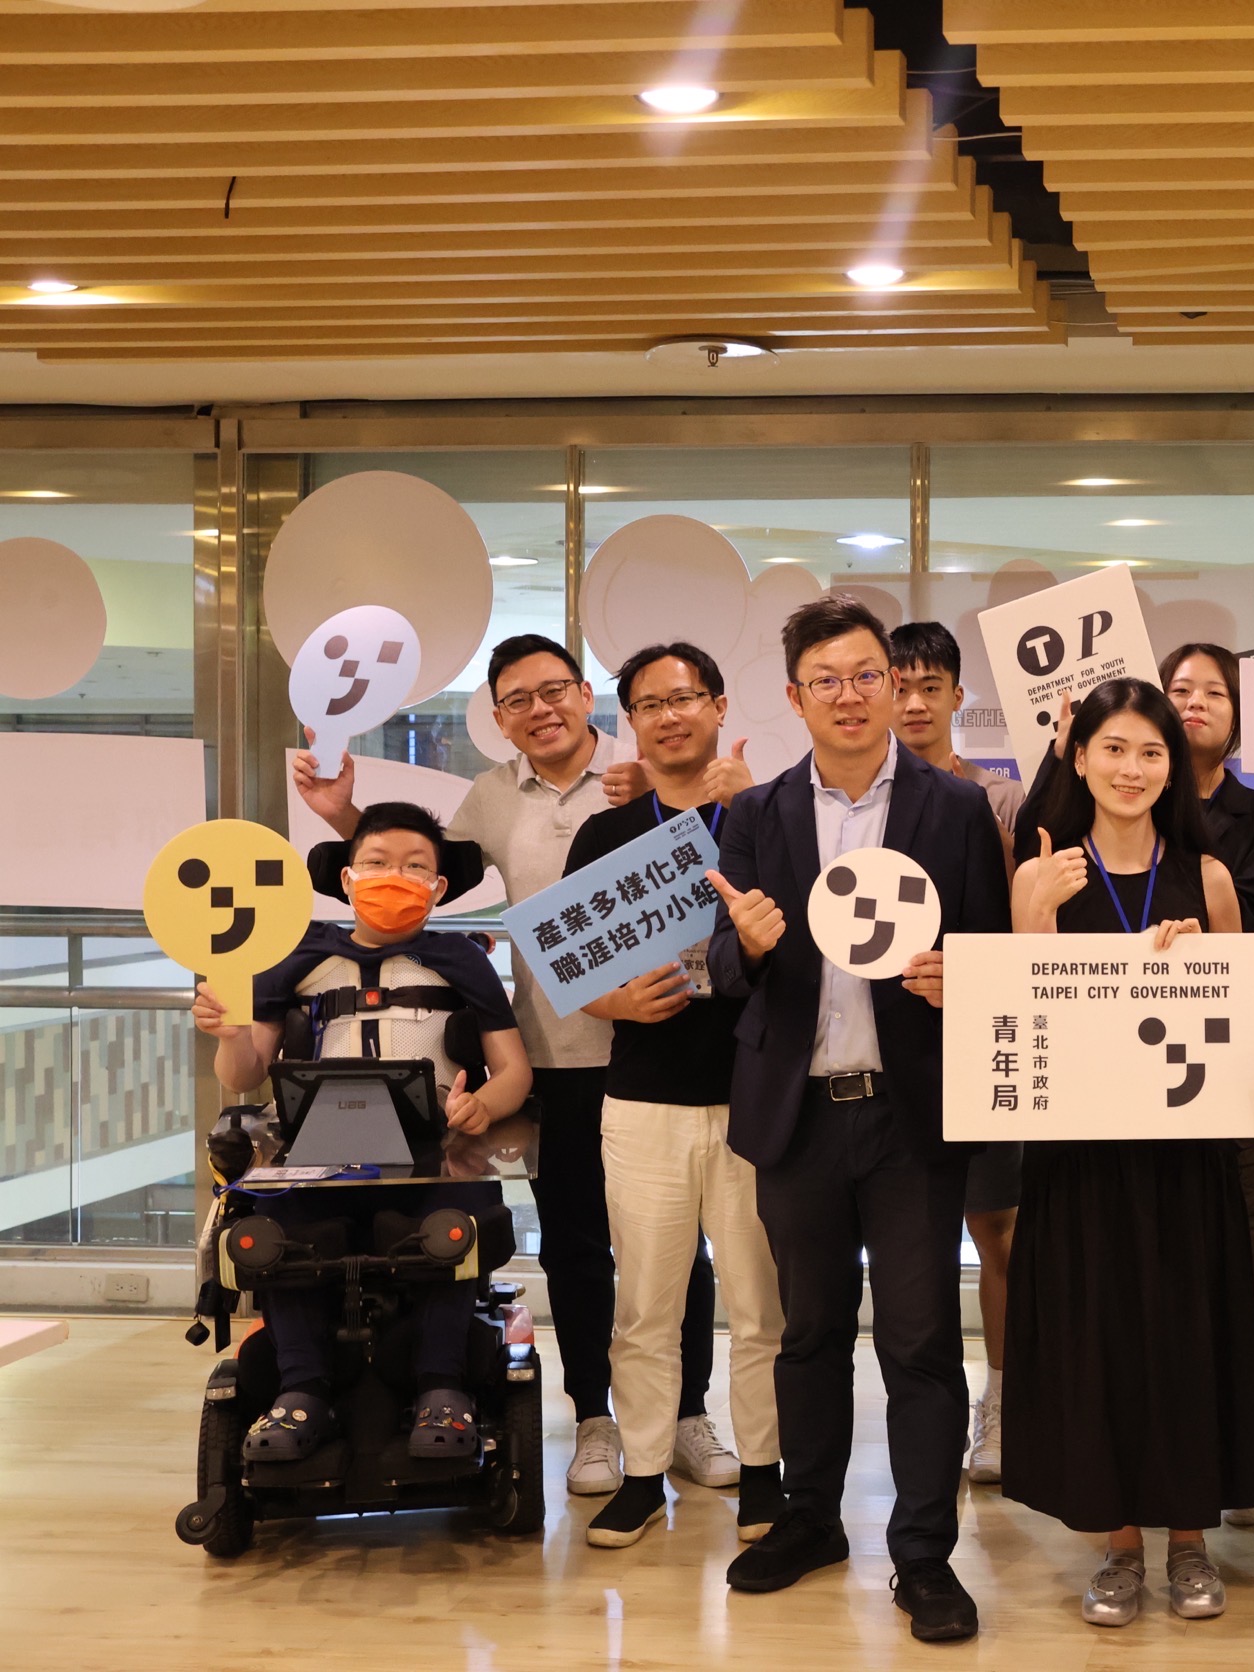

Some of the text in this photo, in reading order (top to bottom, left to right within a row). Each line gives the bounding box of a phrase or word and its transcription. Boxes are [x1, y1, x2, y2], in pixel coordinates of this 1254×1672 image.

[1027, 657, 1125, 697] DEPARTMENT FOR YOUTH
[1030, 691, 1054, 706] TAIPEI
[1077, 666, 1127, 690] GOVERNMENT
[951, 708, 1007, 728] GETHE
[532, 841, 703, 953] 產業多樣化與
[549, 877, 718, 985] 職涯培力小組
[1031, 962, 1230, 976] DEPARTMENT FOR YOUTH
[1032, 985, 1230, 999] TAIPEI CITY GOVERNMENT
[991, 1015, 1020, 1111] 青年局
[1032, 1015, 1049, 1111] 臺北市政府
